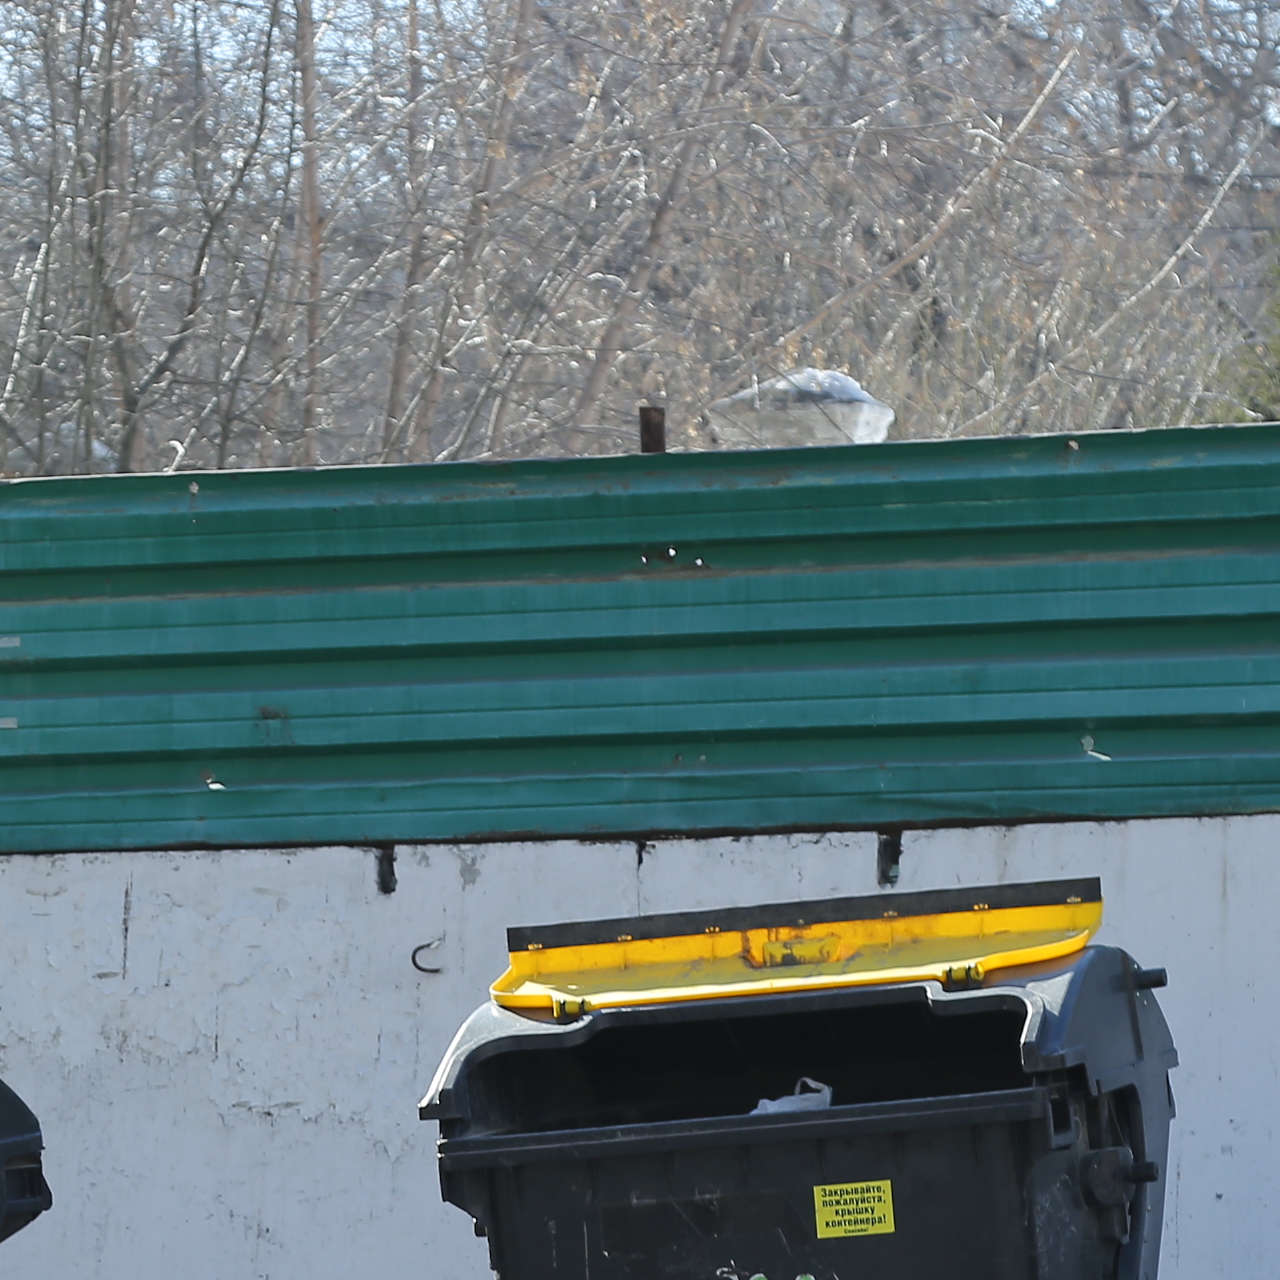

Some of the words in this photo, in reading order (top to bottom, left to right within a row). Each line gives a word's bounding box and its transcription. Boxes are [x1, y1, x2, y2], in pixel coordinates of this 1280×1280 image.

[821, 1184, 886, 1198] Закрывайте,
[822, 1195, 887, 1208] пожалуйста,
[835, 1206, 875, 1218] крышку
[825, 1213, 887, 1228] контейнера!
